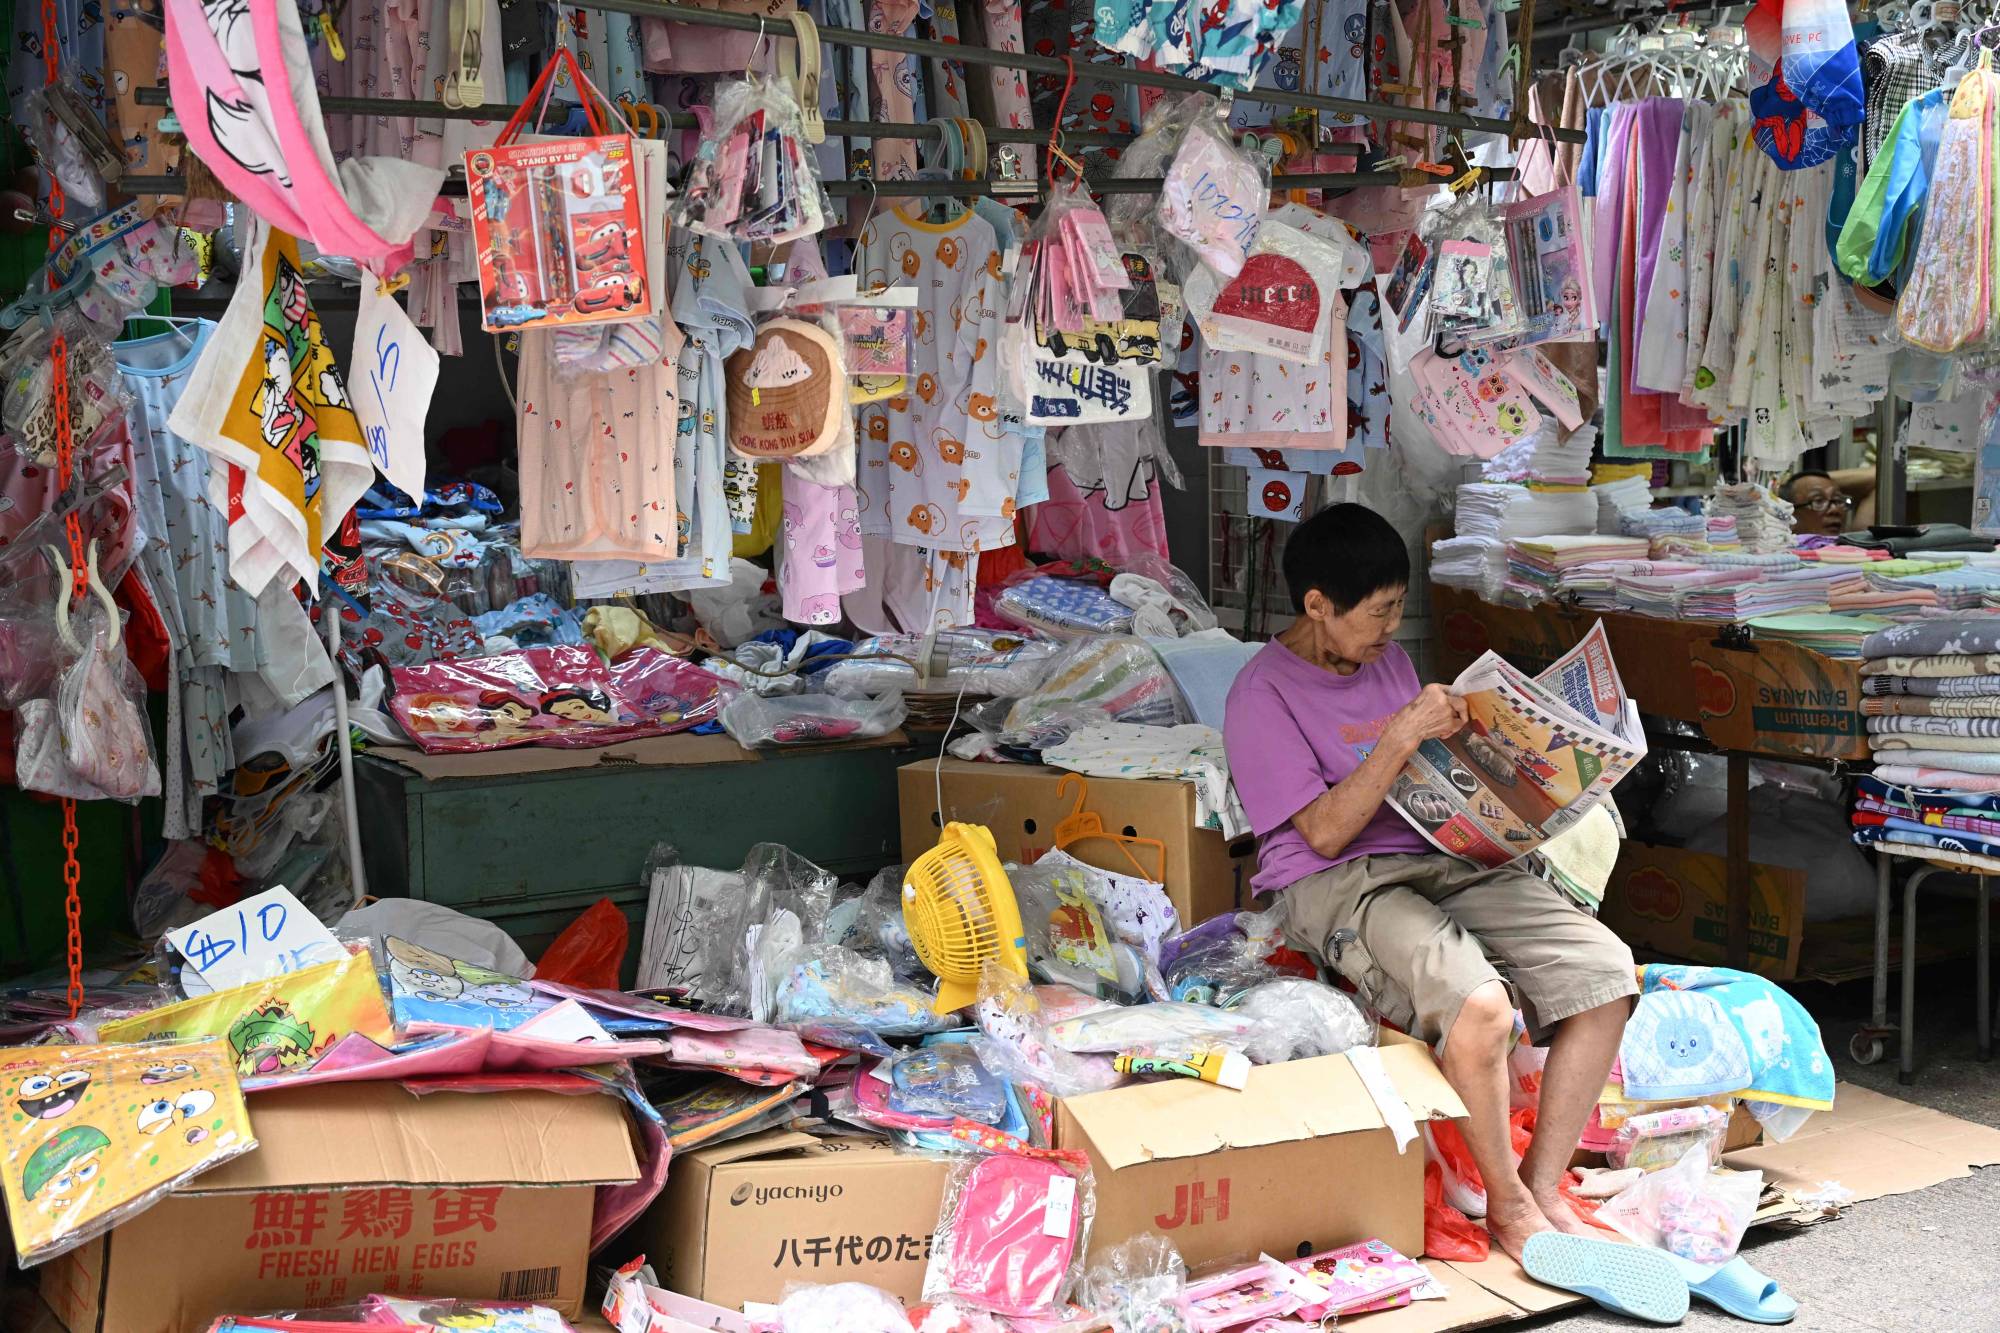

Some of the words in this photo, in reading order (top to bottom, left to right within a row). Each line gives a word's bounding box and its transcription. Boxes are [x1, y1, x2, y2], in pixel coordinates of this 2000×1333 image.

[517, 156, 547, 167] STAND
[549, 155, 561, 163] BY
[564, 153, 578, 161] ME
[1241, 284, 1311, 304] mecca
[760, 439, 778, 450] KONG
[799, 428, 815, 444] SUM
[1759, 688, 1848, 707] BANANAS
[1775, 711, 1849, 731] Premium
[185, 903, 287, 972] $10
[755, 1184, 843, 1206] yachiyo
[1155, 1178, 1230, 1230] JH
[258, 1248, 340, 1279] FRESH
[351, 1245, 400, 1274] HEN
[413, 1240, 478, 1269] EGGS
